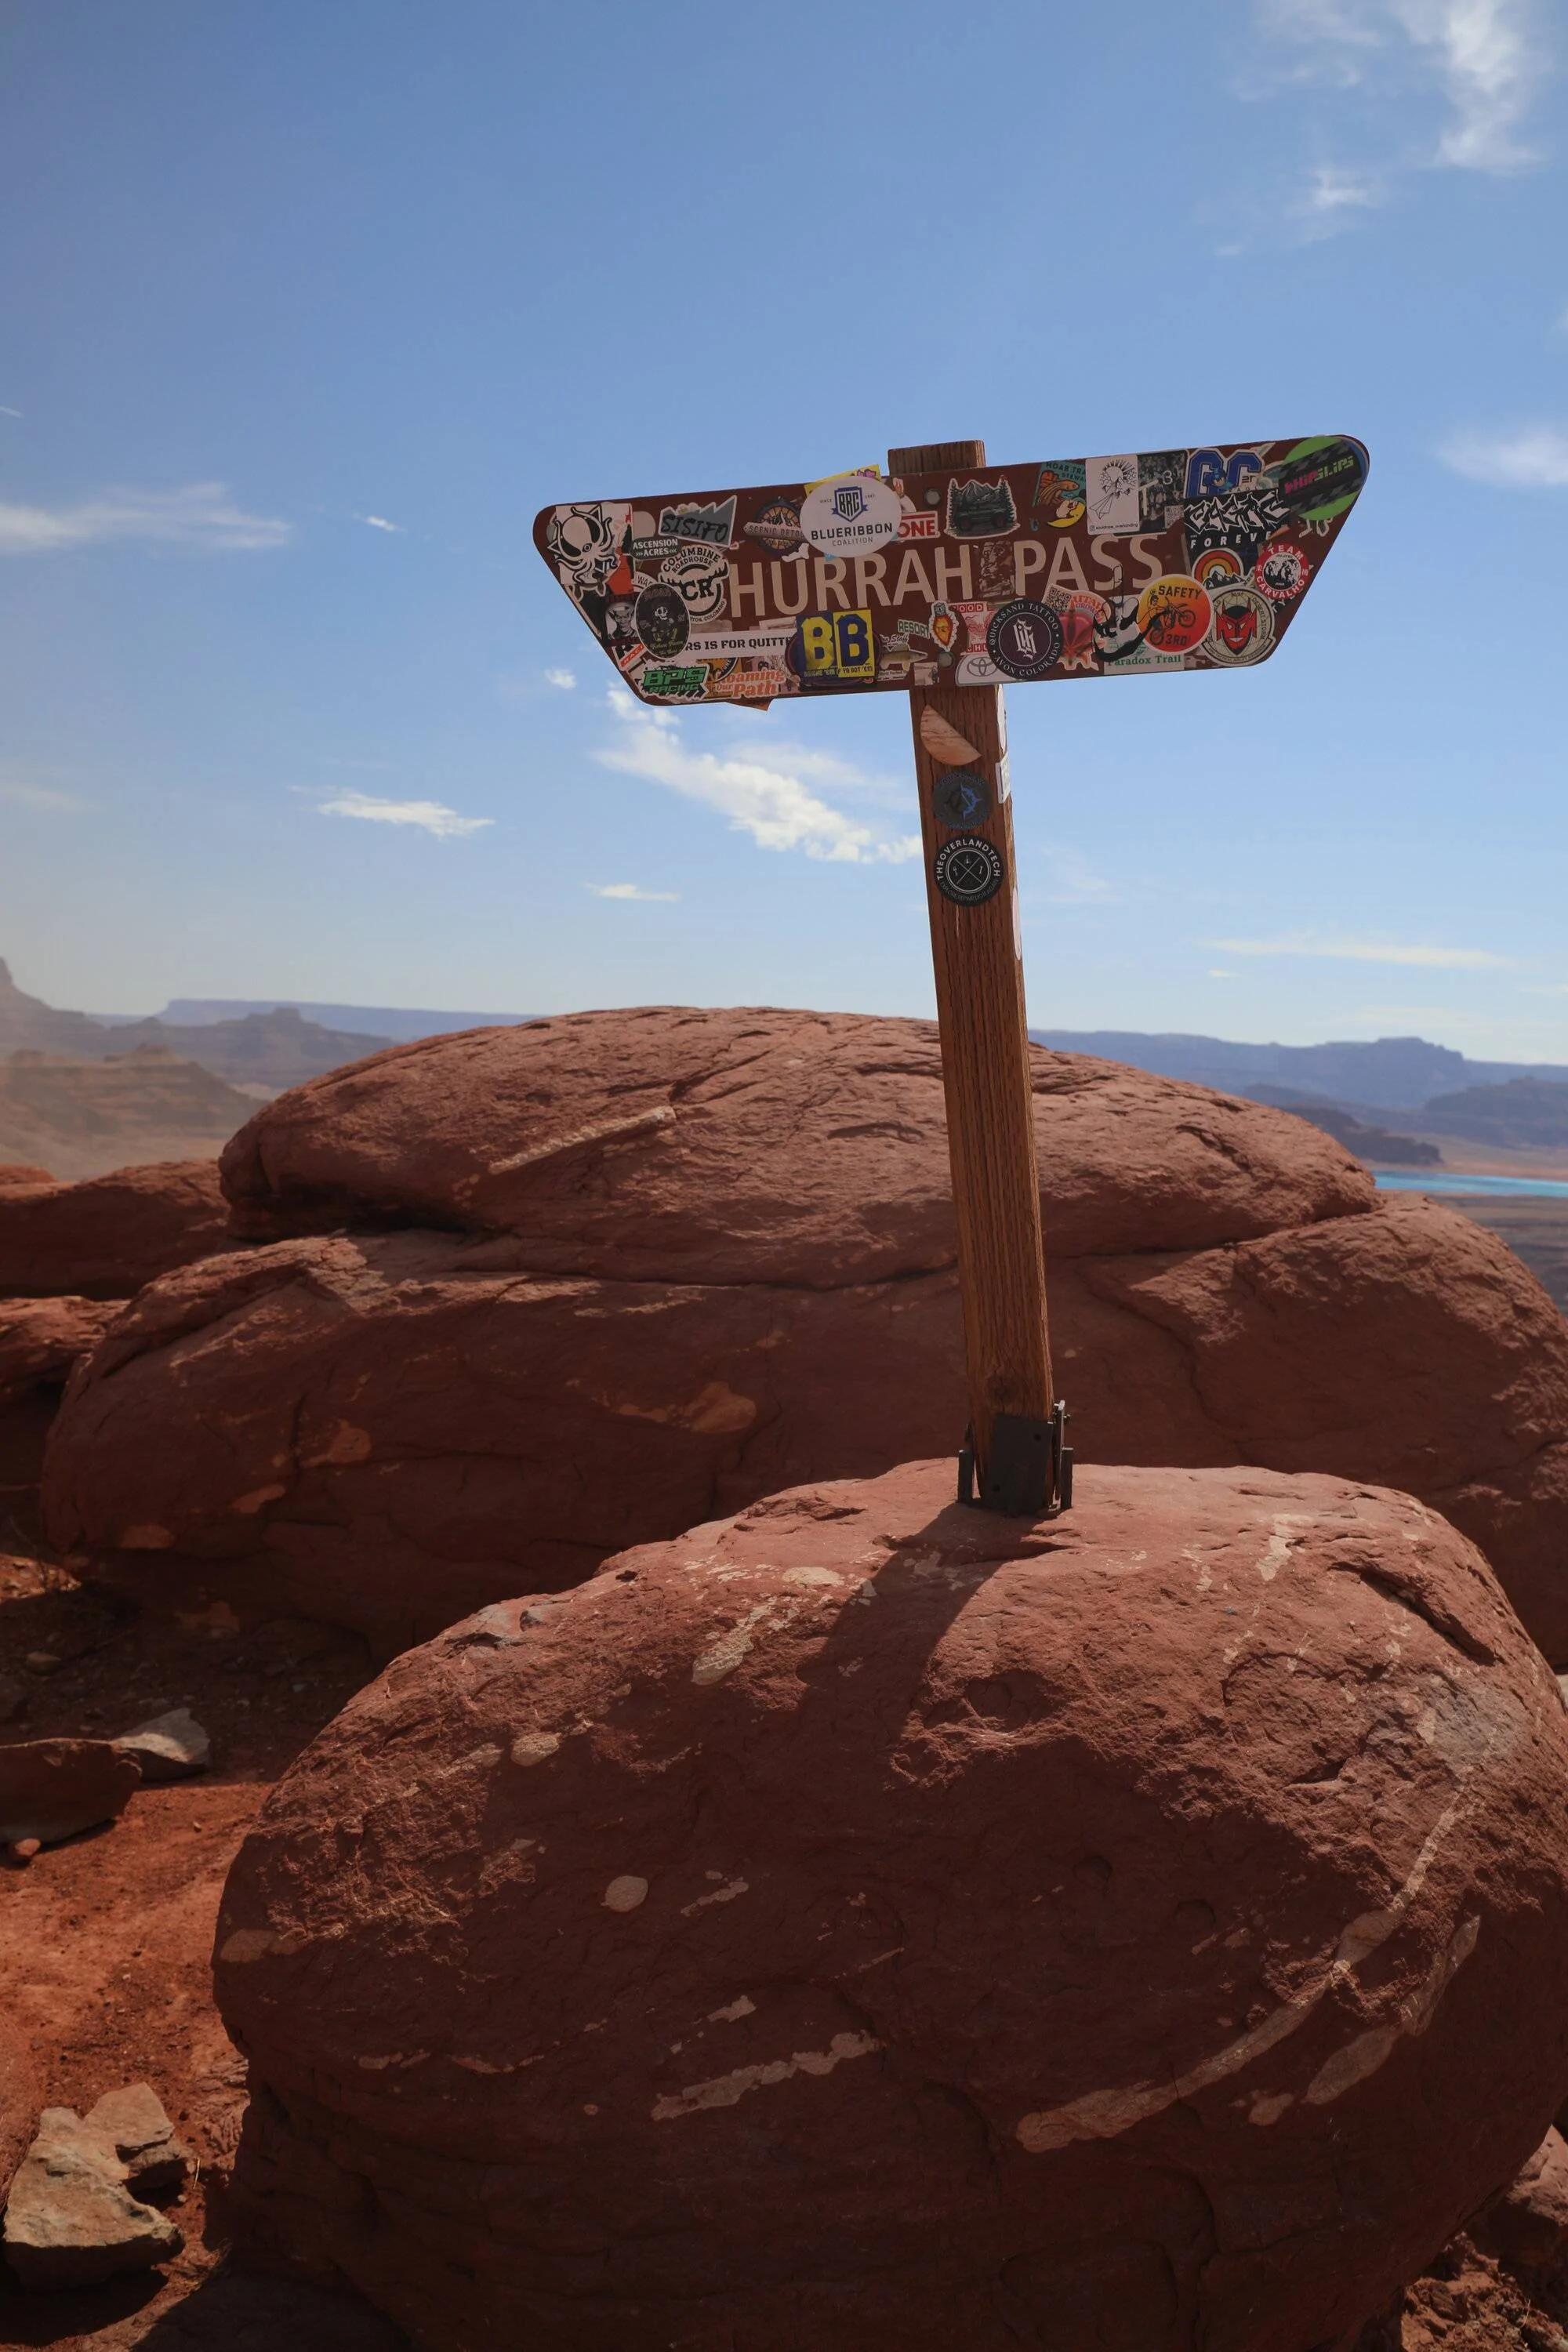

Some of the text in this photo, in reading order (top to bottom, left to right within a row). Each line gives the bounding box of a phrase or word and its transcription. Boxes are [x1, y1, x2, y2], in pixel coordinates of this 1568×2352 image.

[838, 492, 860, 517] BRC
[661, 514, 728, 543] SISIFO
[749, 524, 778, 535] SCENIC
[811, 522, 893, 540] BLUERIBBON
[633, 538, 678, 550] ASCENSION
[832, 536, 873, 546] COALITION
[643, 547, 669, 557] ACRES
[663, 546, 720, 572] COLUMBINE
[1267, 544, 1304, 561] TEAM
[671, 555, 713, 573] ROADHOUSE
[729, 533, 1163, 618] HURRAH PASS
[681, 579, 714, 601] CR
[1158, 586, 1202, 600] SAFETY
[1256, 575, 1305, 599] CARVALHO
[898, 620, 931, 639] RESORT
[989, 603, 1025, 645] QUICKSAND
[1028, 603, 1059, 630] TATTOO
[705, 641, 718, 650] IS
[721, 639, 746, 649] FOR
[994, 642, 1061, 677] AVON COLORADO
[1155, 655, 1182, 663] Trail
[643, 666, 707, 688] BPS
[649, 684, 699, 694] RACING
[716, 681, 778, 698] Our Path
[936, 838, 1001, 881] THEOVERLANDTECH
